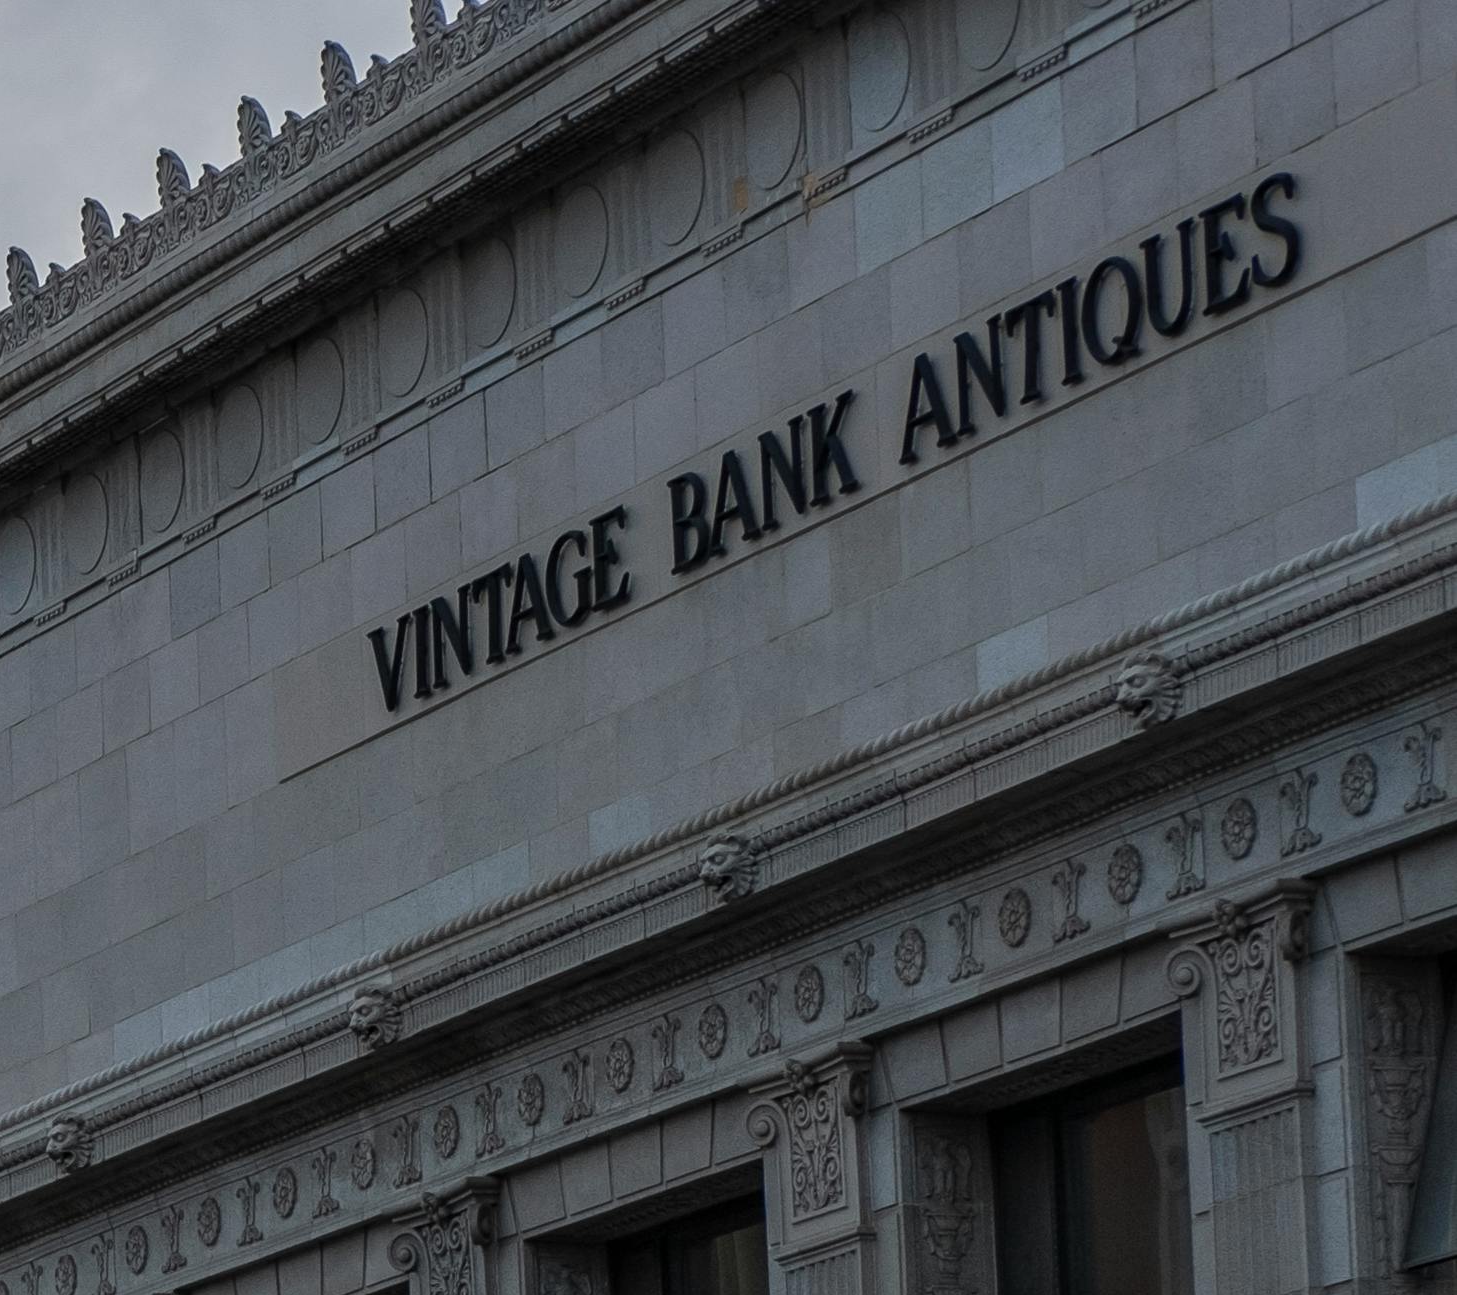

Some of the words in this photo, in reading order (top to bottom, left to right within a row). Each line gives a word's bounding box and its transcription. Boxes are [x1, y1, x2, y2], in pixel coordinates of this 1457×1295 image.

[366, 504, 631, 711] VINTAGE
[668, 388, 863, 577] BANK
[900, 171, 1304, 465] ANTIQUES
